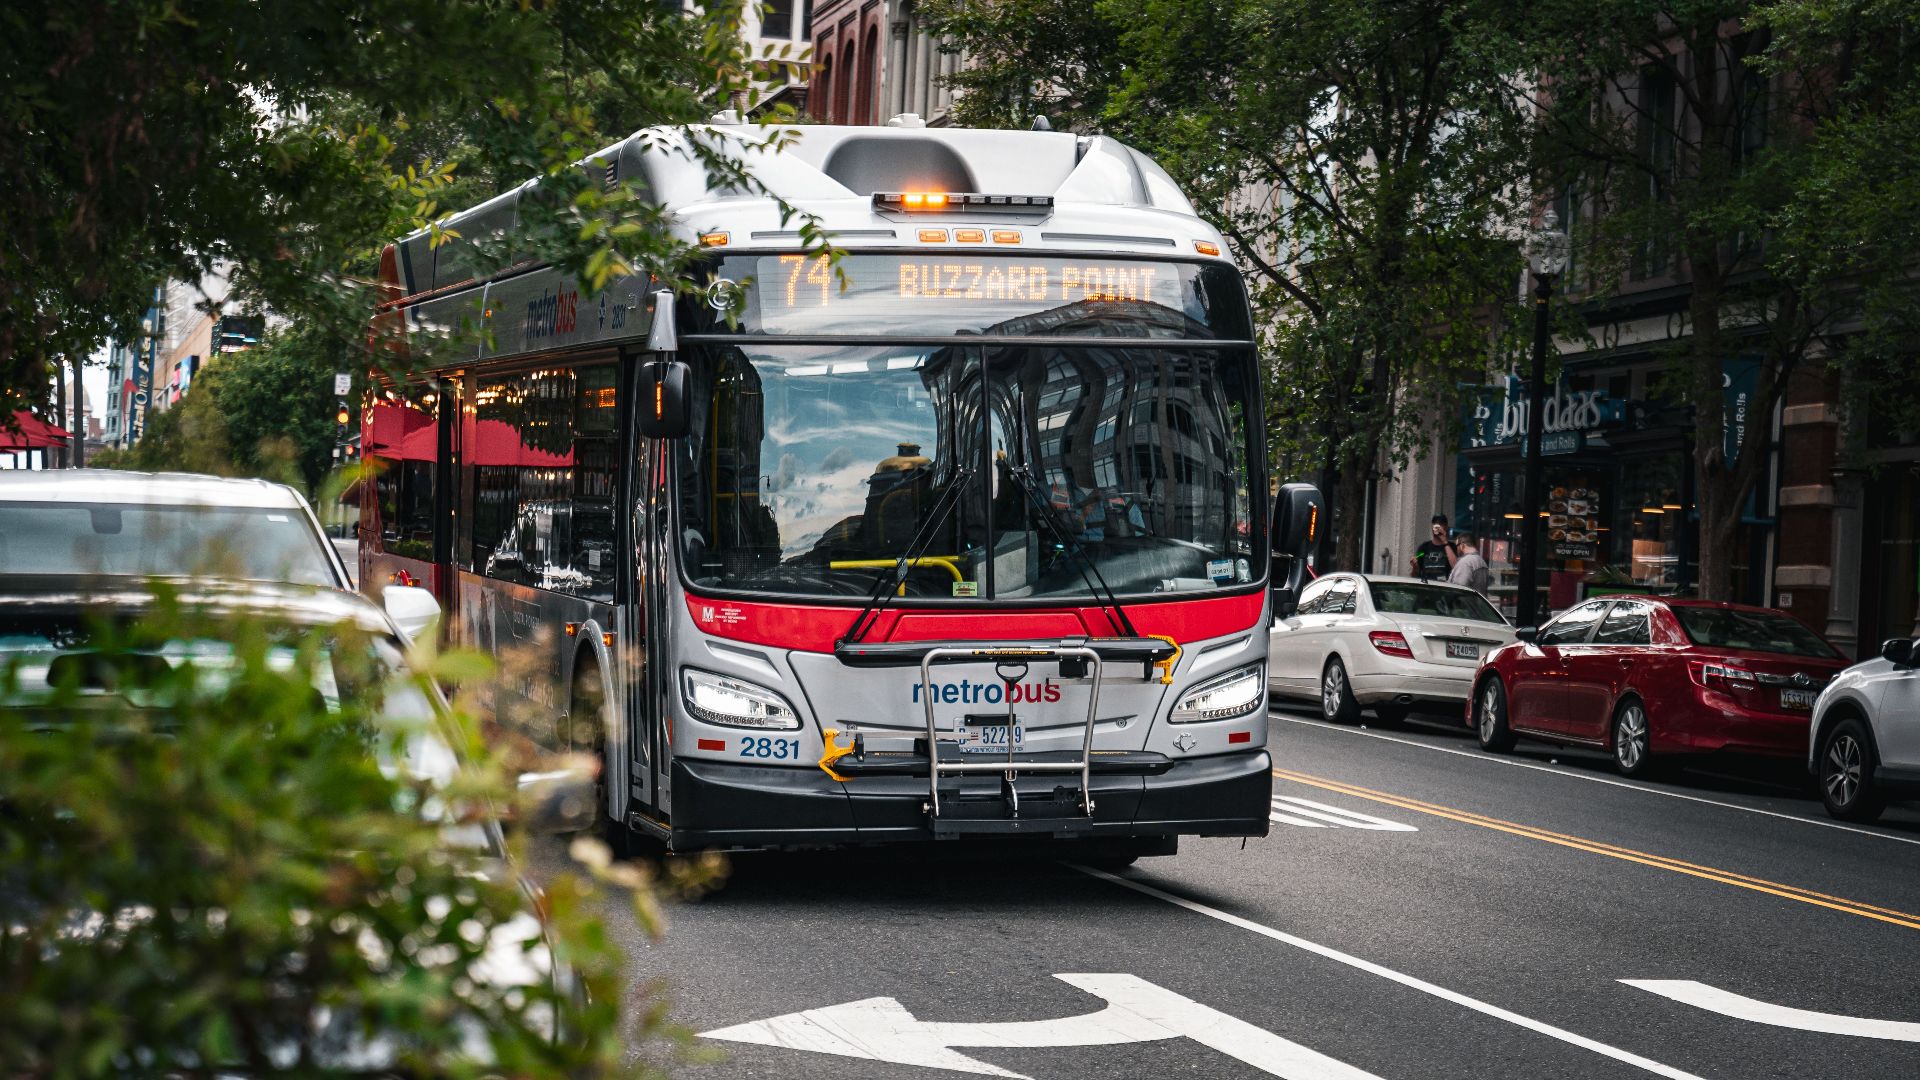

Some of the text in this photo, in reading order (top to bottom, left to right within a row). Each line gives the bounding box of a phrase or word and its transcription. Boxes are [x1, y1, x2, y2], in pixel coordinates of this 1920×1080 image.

[780, 254, 830, 306] 74
[900, 265, 1157, 301] BUZZARD POINT
[526, 281, 577, 339] metrobus
[611, 304, 626, 329] 2831
[1559, 436, 1576, 449] Rolls
[913, 679, 1060, 704] metrobus
[740, 737, 799, 760] 2831
